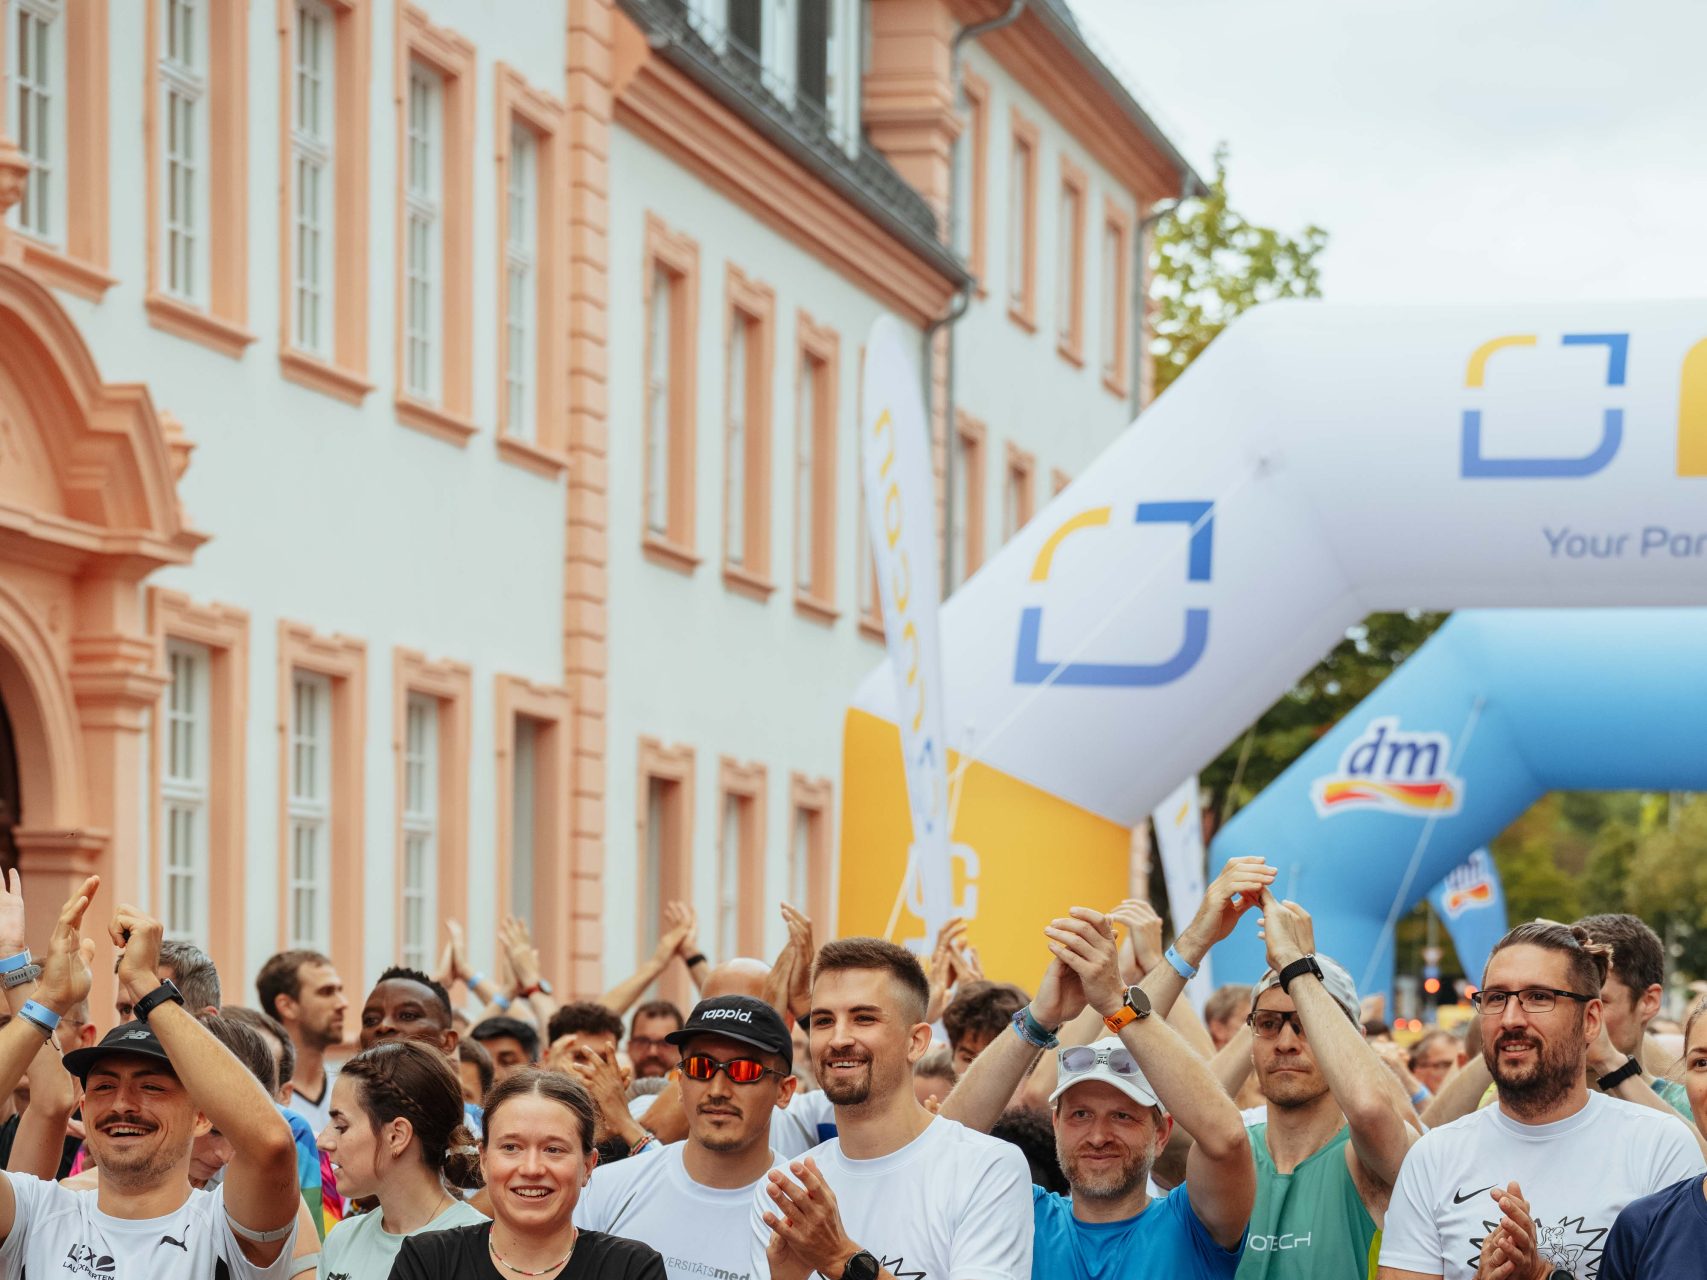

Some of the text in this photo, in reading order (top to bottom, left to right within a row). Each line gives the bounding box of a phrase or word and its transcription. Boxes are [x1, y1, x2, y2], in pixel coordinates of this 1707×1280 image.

[1542, 526, 1630, 558] Your
[1348, 726, 1440, 775] dm
[701, 1008, 752, 1024] rappid.
